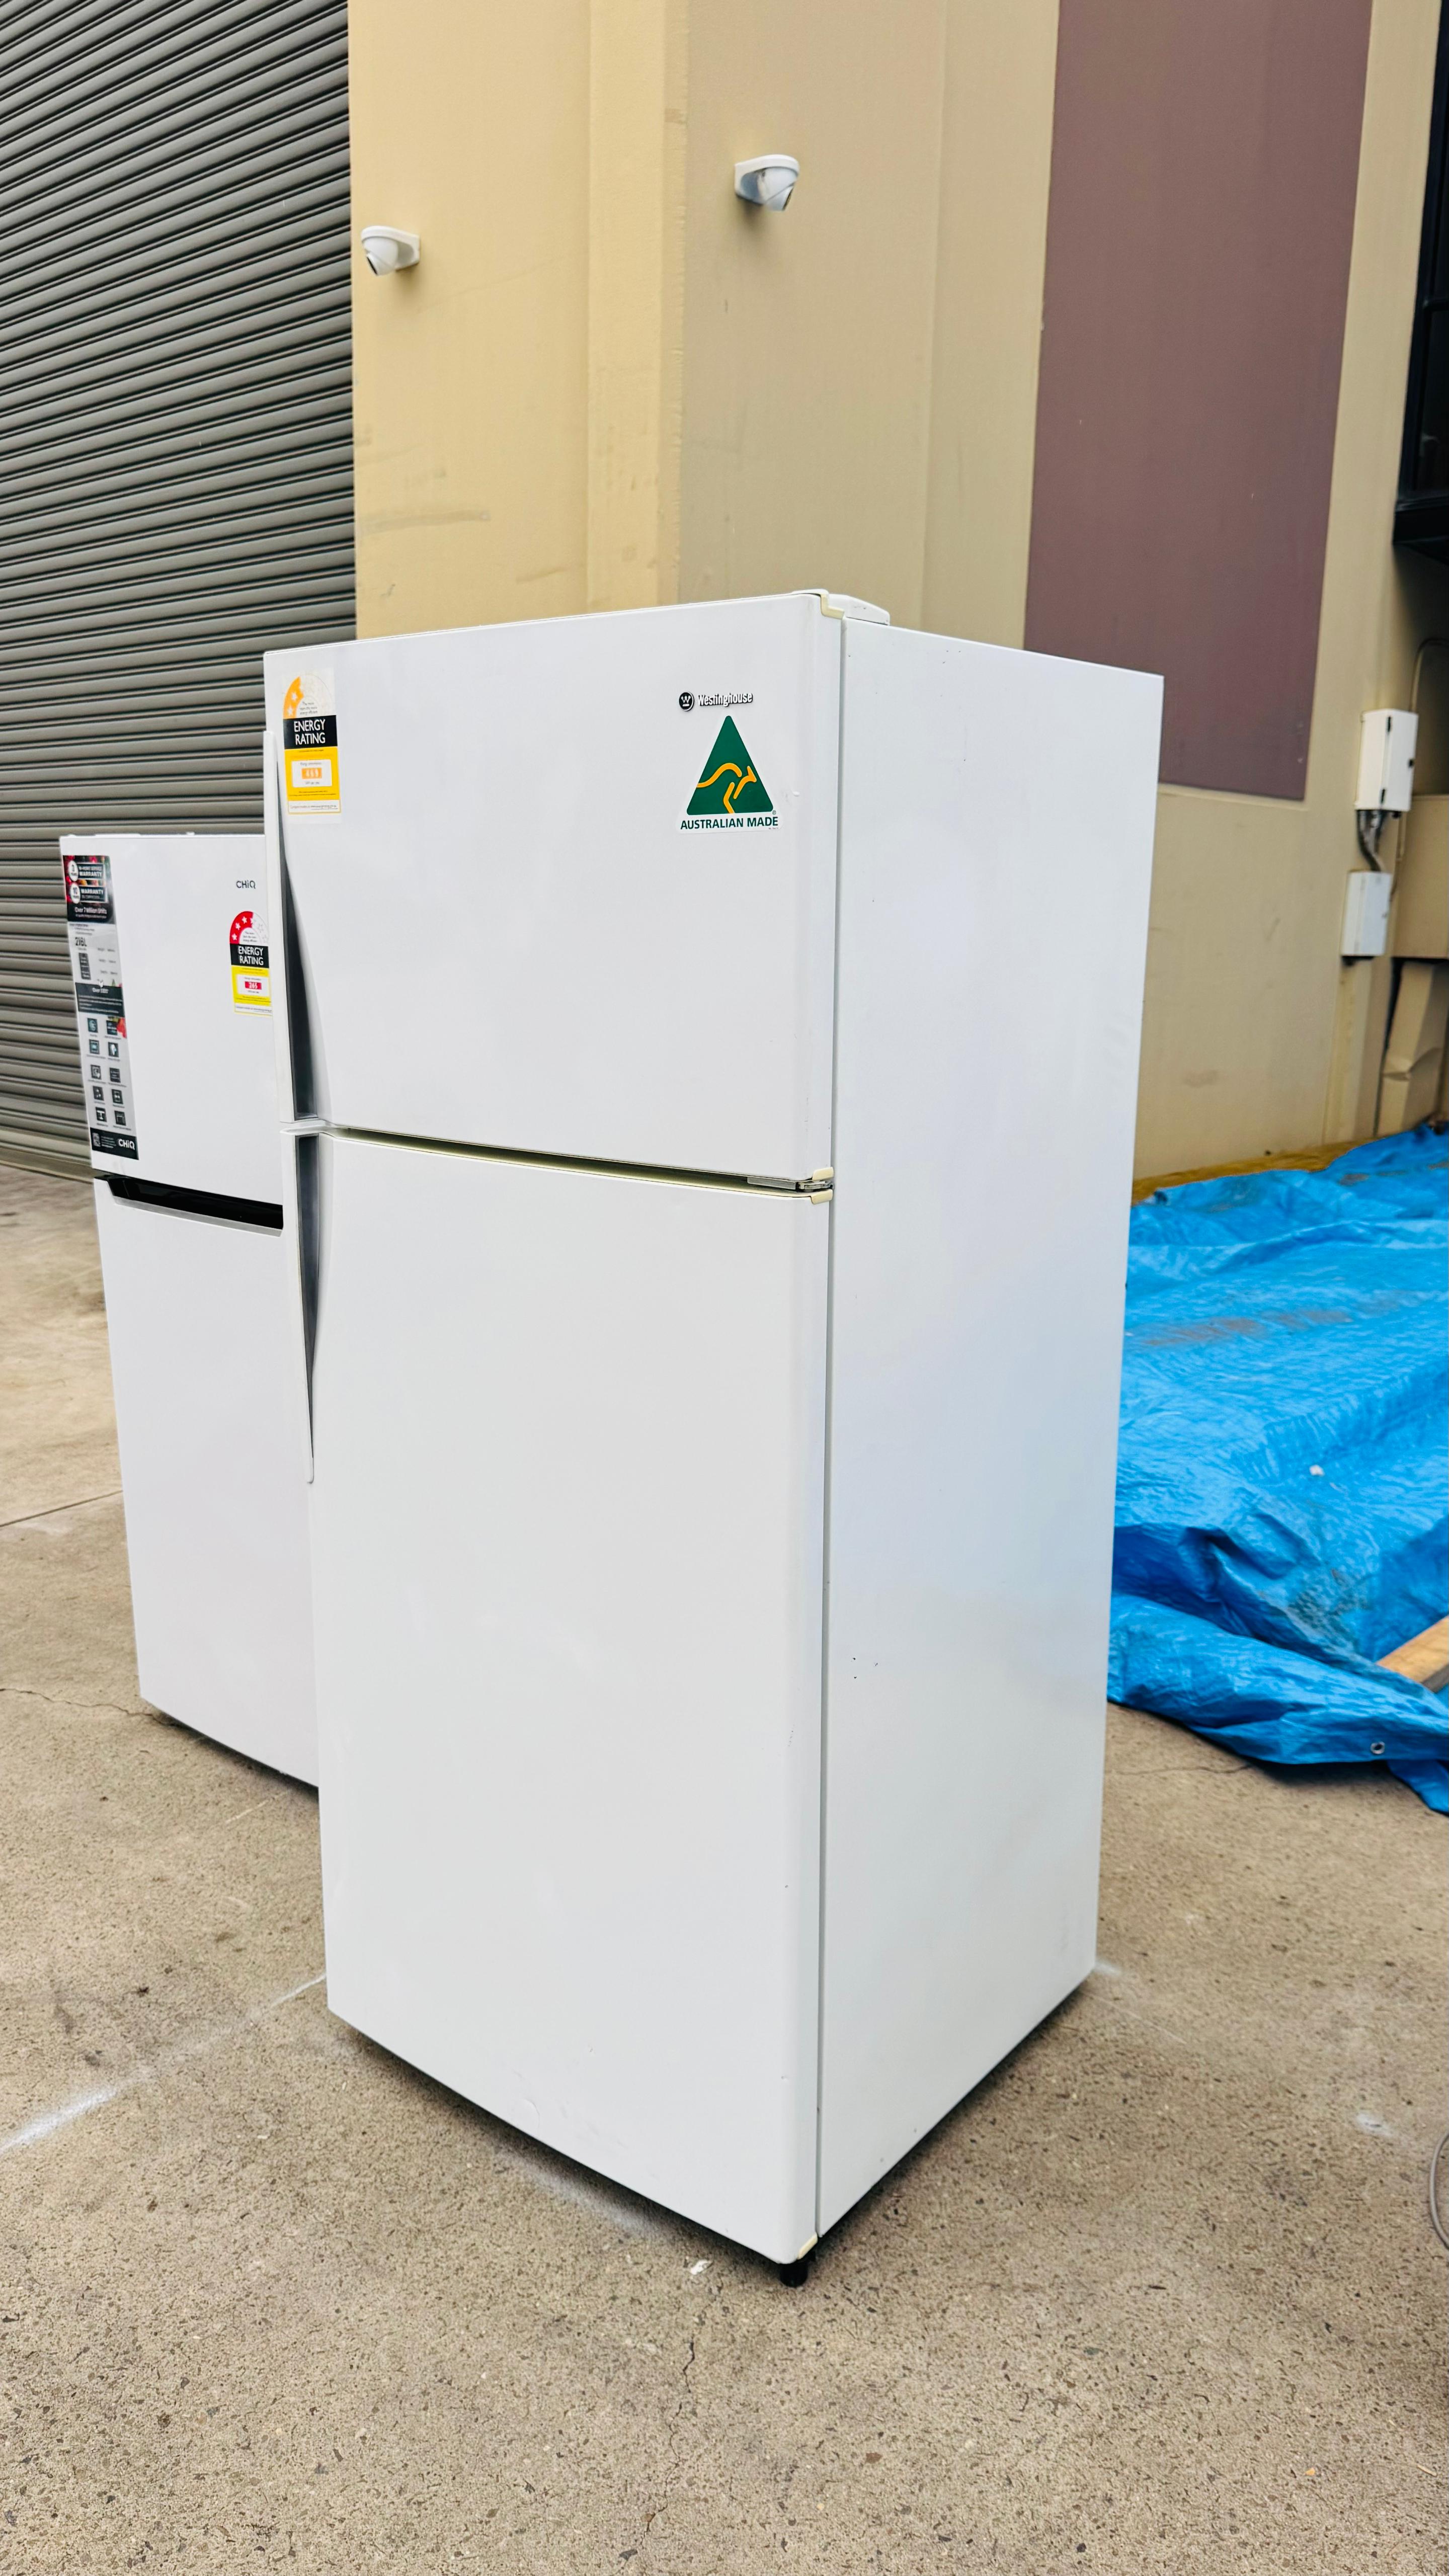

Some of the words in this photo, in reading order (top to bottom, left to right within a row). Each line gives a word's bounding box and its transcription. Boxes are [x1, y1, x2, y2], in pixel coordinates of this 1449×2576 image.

[698, 692, 753, 707] Westinghouse
[293, 718, 326, 733] ENERGY
[295, 732, 326, 745] RATING
[680, 818, 744, 830] AUSTRALIAN
[747, 817, 778, 827] MADE
[238, 945, 264, 956] ENERGY
[239, 955, 264, 965] RATING
[118, 1138, 135, 1151] CHiQ
